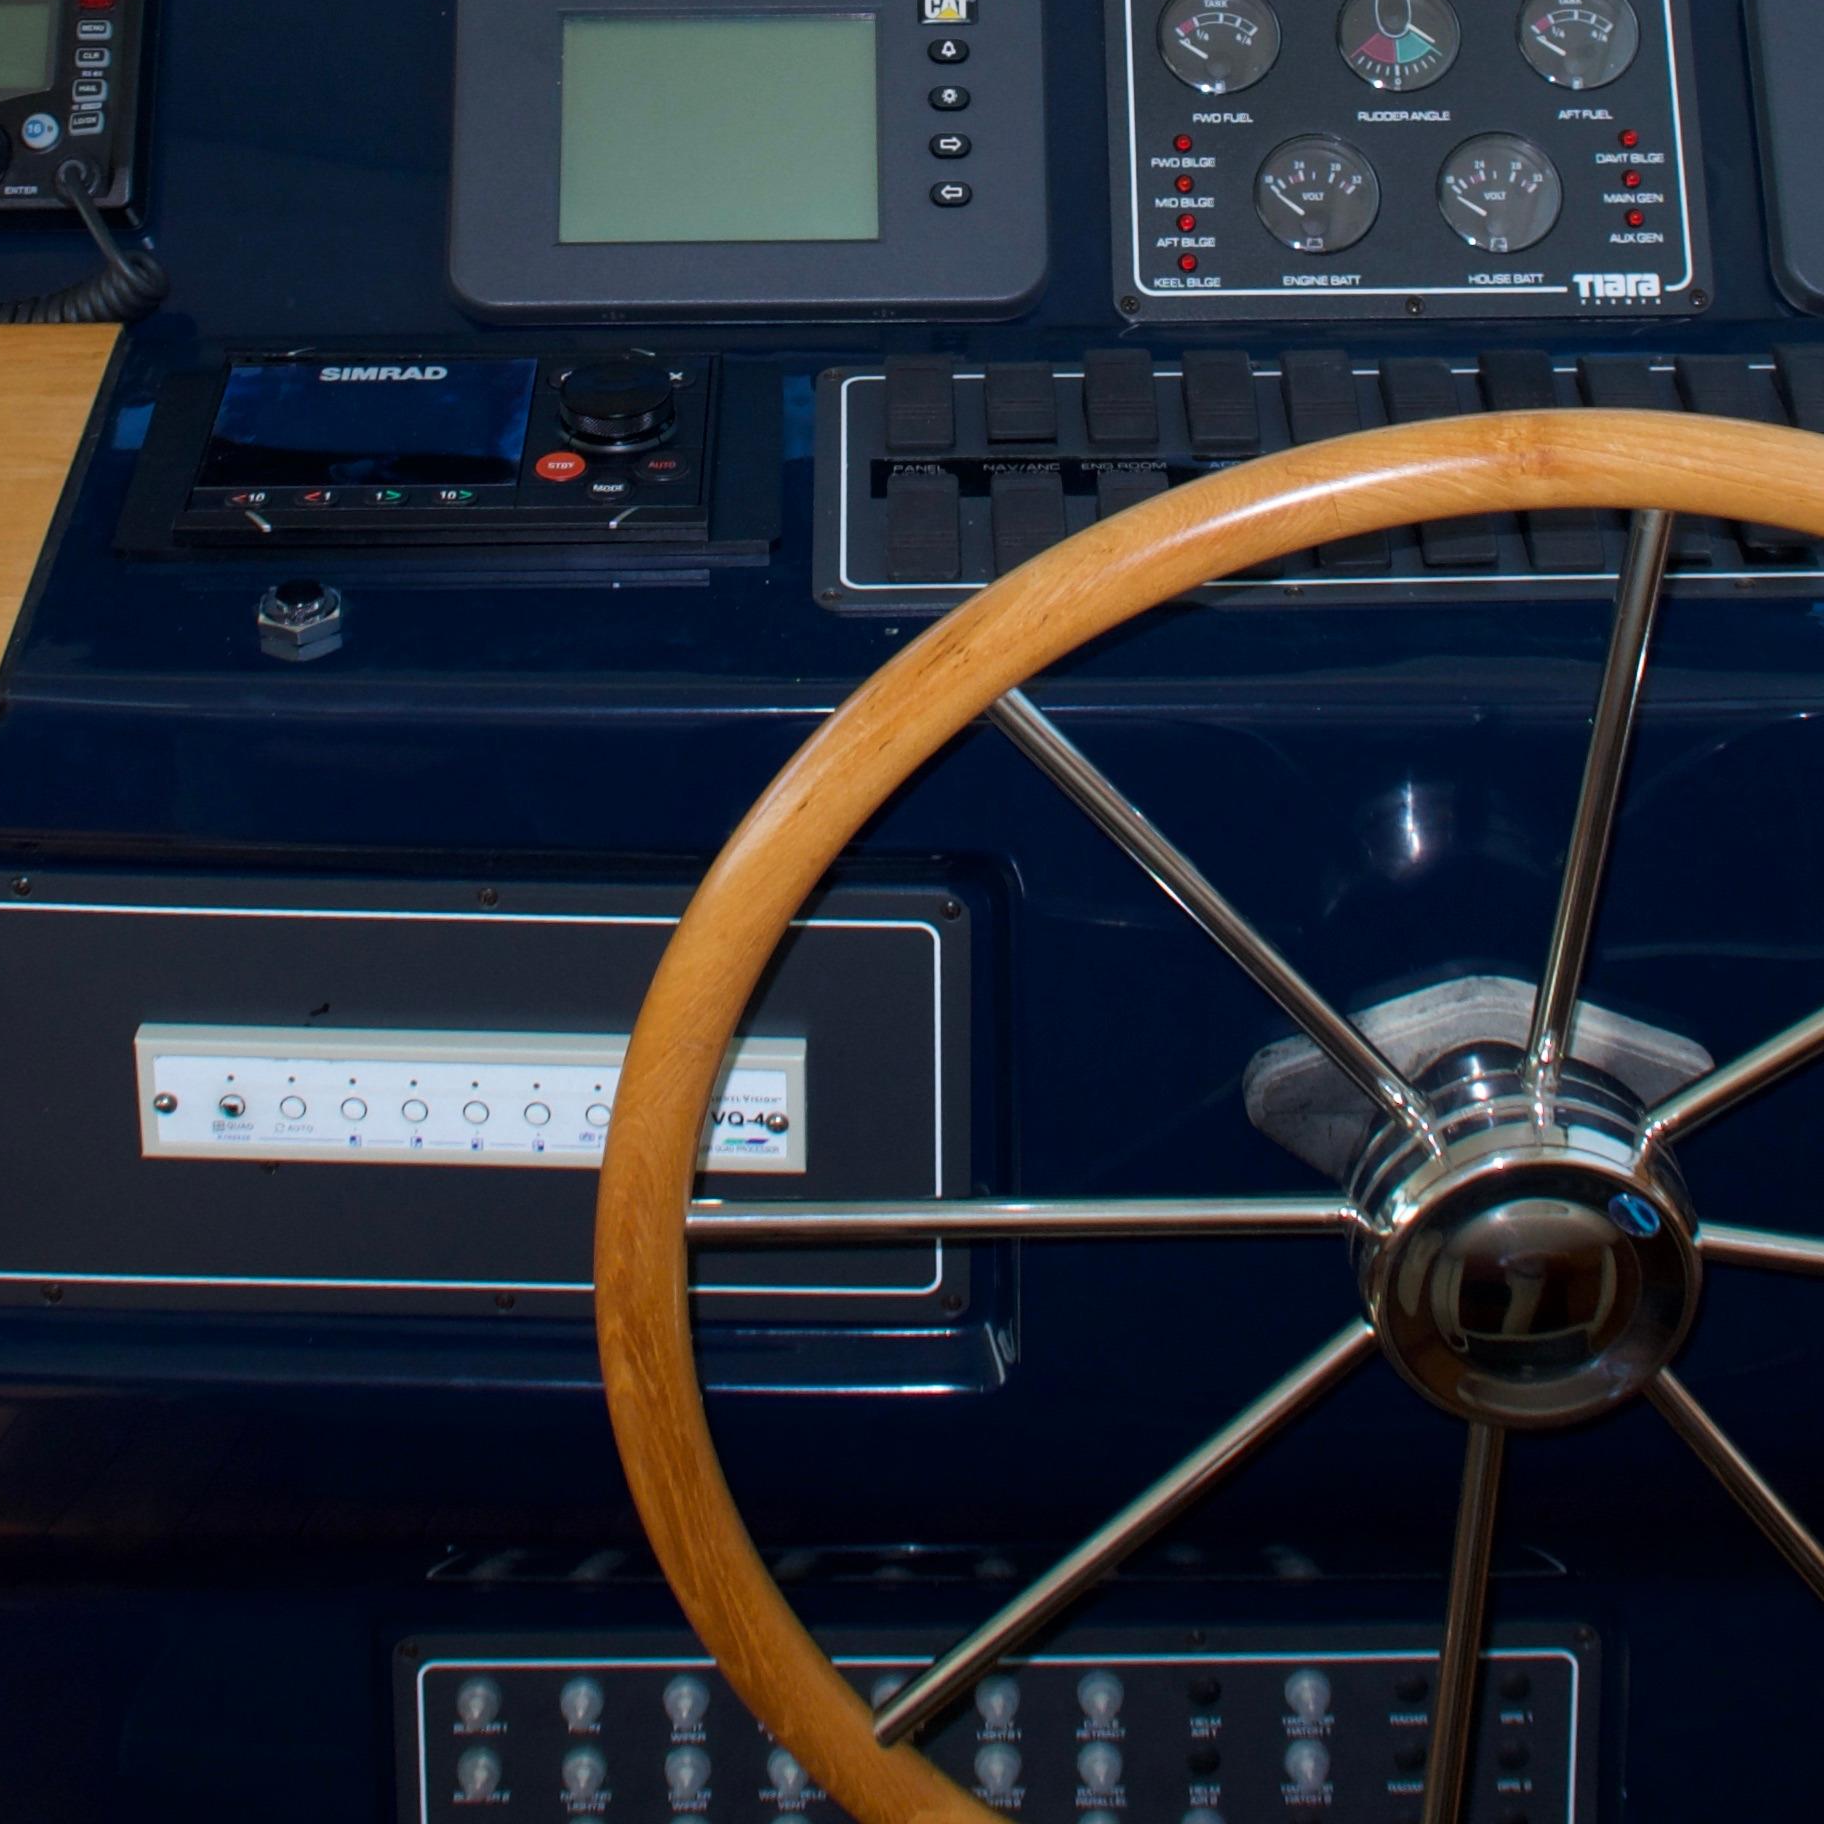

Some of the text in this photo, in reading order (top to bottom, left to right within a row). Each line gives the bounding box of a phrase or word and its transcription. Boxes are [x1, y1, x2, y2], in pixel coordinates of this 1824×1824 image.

[1203, 0, 1229, 8] TANK
[1193, 112, 1254, 124] FWD FUEL
[1357, 110, 1451, 122] RUDDER ANGLE
[1558, 109, 1613, 121] AFT FUEL
[1151, 157, 1216, 169] FWD BILGE
[1596, 153, 1665, 164] DAVIT BILGE
[1301, 191, 1325, 202] VOLT
[1483, 191, 1507, 201] VOLT
[1603, 193, 1664, 204] MAIN GEN
[1155, 197, 1215, 209] MID BILGE
[1156, 237, 1216, 248] AFT BILGE
[1609, 232, 1664, 244] AUX GEN
[1153, 277, 1221, 288] KEEL BILGE
[1282, 275, 1361, 287] ENGINE BATT
[1468, 273, 1544, 285] HOUSE BATT
[319, 365, 449, 382] SIMRAD
[547, 461, 576, 470] STBY
[648, 460, 677, 469] AUTO
[892, 464, 946, 475] PANEL
[982, 462, 1061, 473] NAV/ANC
[593, 483, 625, 493] MODE
